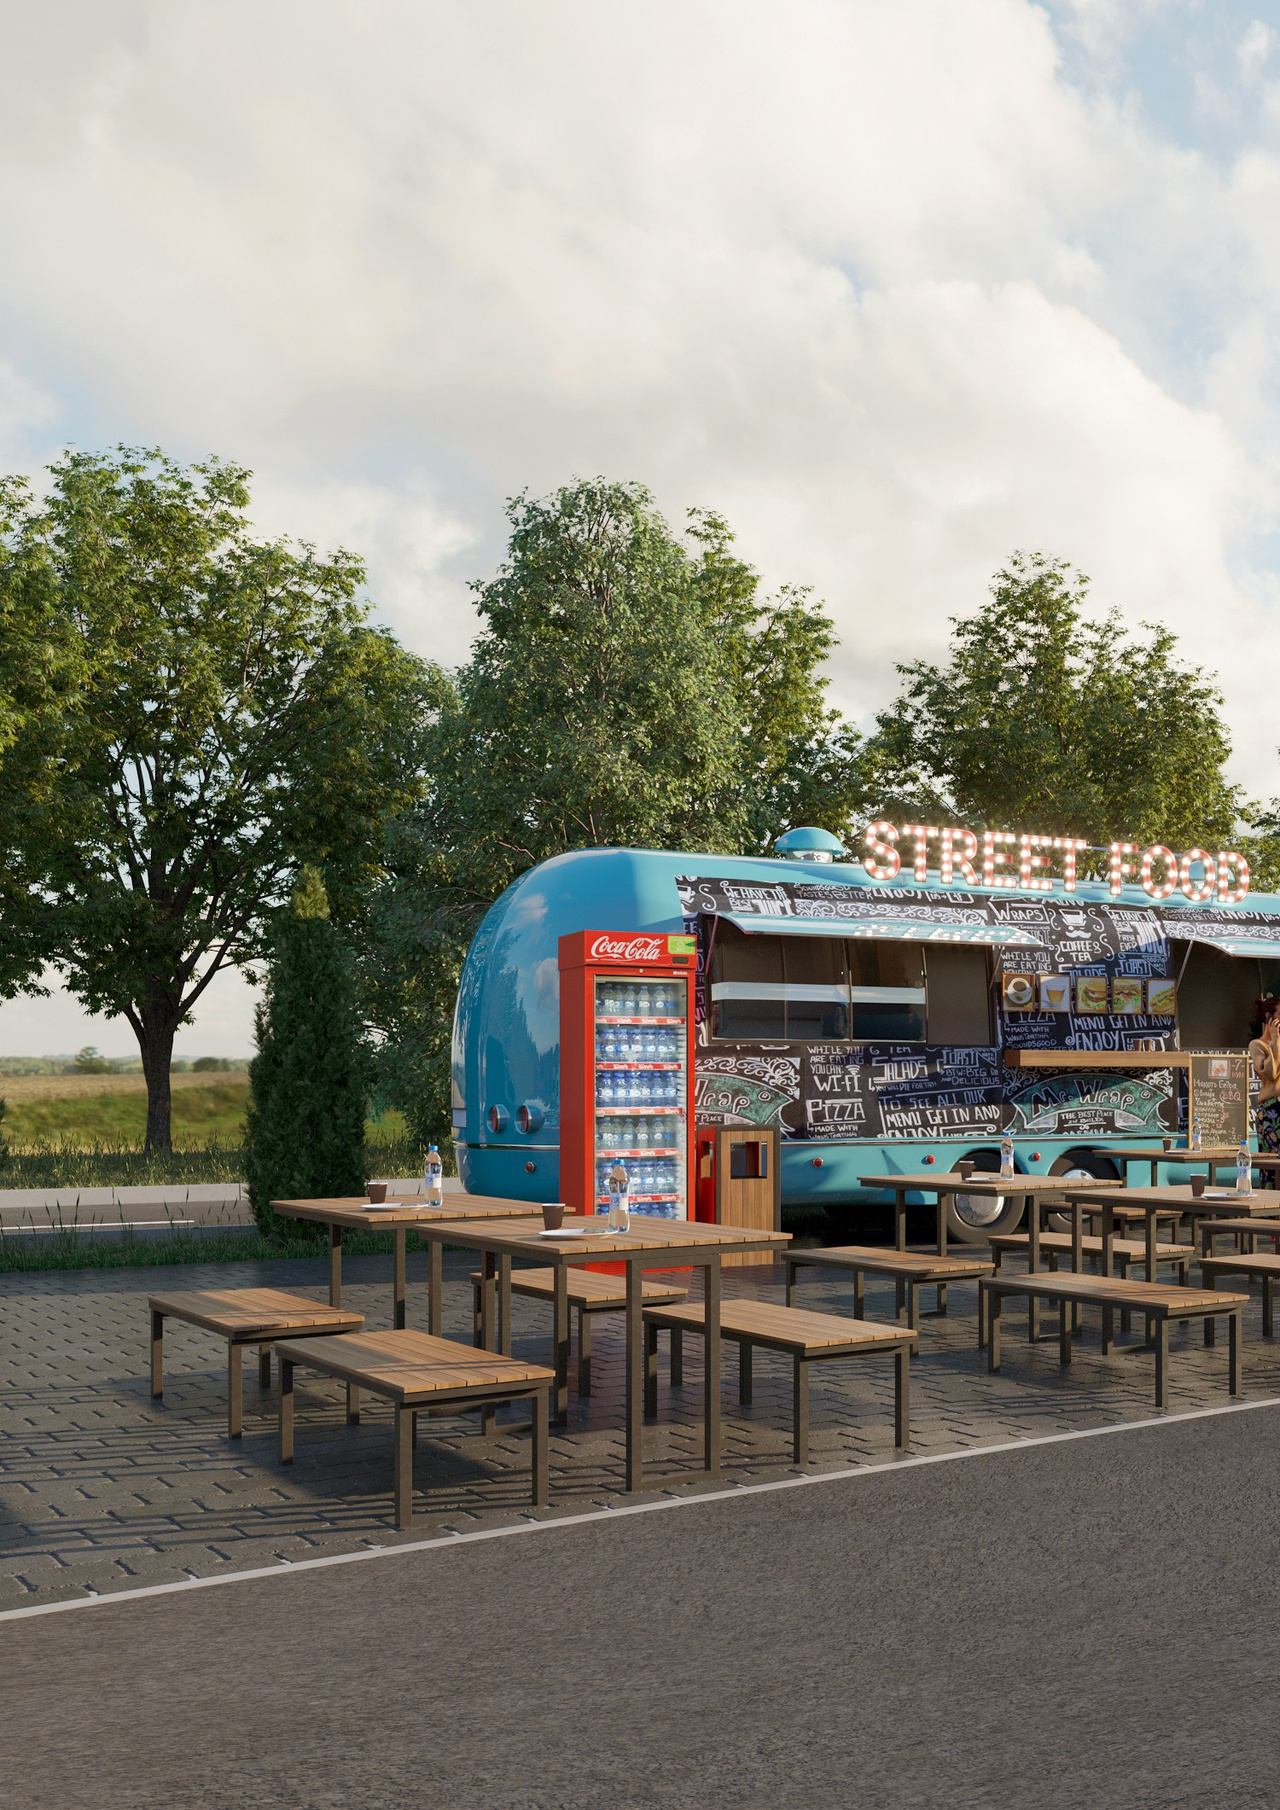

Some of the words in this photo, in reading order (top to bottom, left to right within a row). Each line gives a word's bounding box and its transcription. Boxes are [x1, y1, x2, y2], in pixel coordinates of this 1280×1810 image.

[864, 821, 1088, 893] STREET
[1109, 842, 1250, 903] FOOD
[740, 888, 771, 899] HAVE
[987, 901, 1044, 921] WRAPS
[591, 936, 665, 960] Coca-Cola
[1060, 940, 1092, 952] COFFEE
[1001, 952, 1032, 961] WHILE
[1034, 951, 1050, 963] YOU
[1070, 952, 1092, 962] TEA
[1003, 961, 1018, 969] ARE
[1119, 959, 1148, 974] TOAST
[1031, 1025, 1049, 1033] WITH
[1074, 1016, 1105, 1031] MENU
[1109, 1015, 1128, 1028] GET
[1132, 1014, 1147, 1029] IN
[1151, 1014, 1171, 1027] AND
[1075, 1030, 1119, 1051] ENJOY
[807, 1046, 842, 1054] WHILE
[942, 1049, 975, 1065] TOAST
[810, 1055, 826, 1064] ARE
[872, 1056, 928, 1081] SALADS
[813, 1074, 862, 1093] WI-FI
[900, 1082, 910, 1091] DIE
[951, 1076, 1000, 1086] DELICIOUS
[878, 1096, 902, 1111] TO
[909, 1097, 932, 1110] SEE
[937, 1092, 961, 1107] ALL
[964, 1089, 987, 1104] OUR
[1032, 1087, 1073, 1118] Mr.
[1074, 1079, 1135, 1110] Wrap
[806, 1098, 866, 1123] PIZZA
[886, 1111, 922, 1128] MENU
[926, 1109, 948, 1125] GET
[951, 1107, 970, 1123] IN
[974, 1105, 1000, 1121] AND
[1060, 1112, 1076, 1120] THE
[1078, 1110, 1096, 1119] BEST
[815, 1124, 835, 1132] MADE
[837, 1123, 858, 1132] WITH
